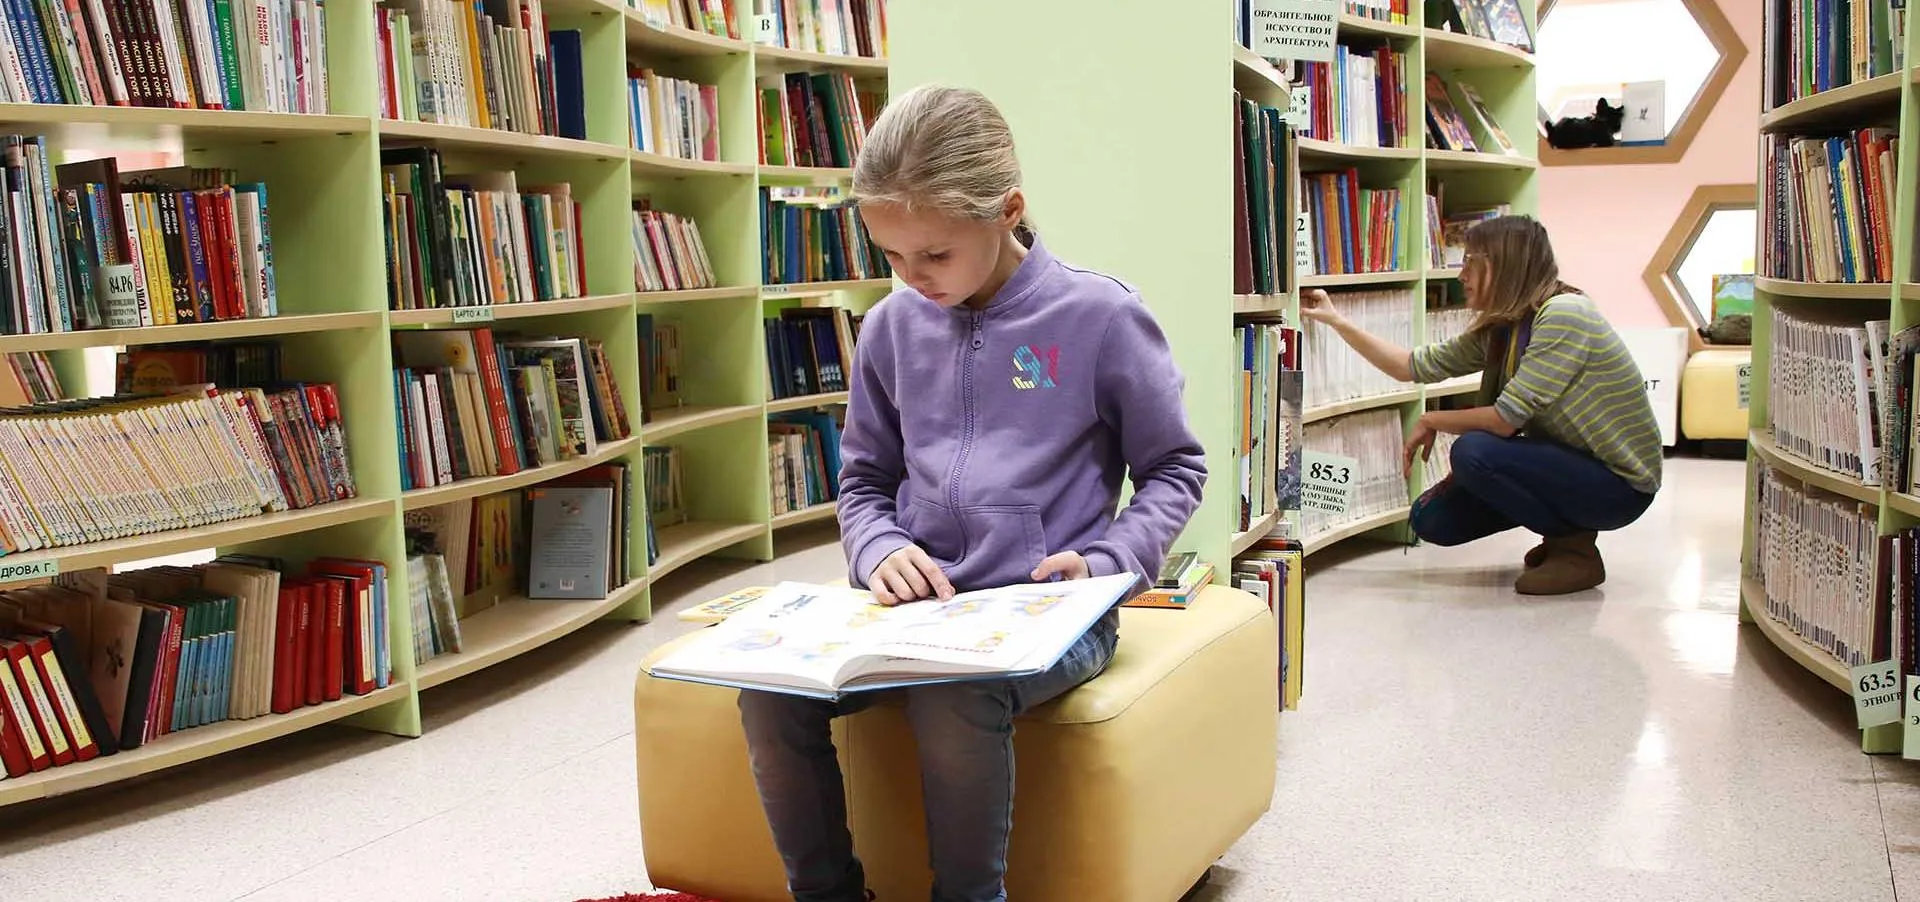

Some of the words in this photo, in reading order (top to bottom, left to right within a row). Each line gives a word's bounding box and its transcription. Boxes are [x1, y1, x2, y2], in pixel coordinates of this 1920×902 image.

[1254, 9, 1334, 22] ОБРАЗИТЕЛЬНОЕ
[1265, 23, 1322, 35] ИСКУССТВО
[1324, 27, 1332, 35] И
[1263, 36, 1330, 48] АРХИТЕКТУРА
[1310, 462, 1350, 484] 85.3
[1320, 503, 1345, 513] ЦИРК)
[1, 565, 40, 578] ДРОВА
[44, 563, 55, 572] Г.
[1860, 670, 1896, 692] 63.5
